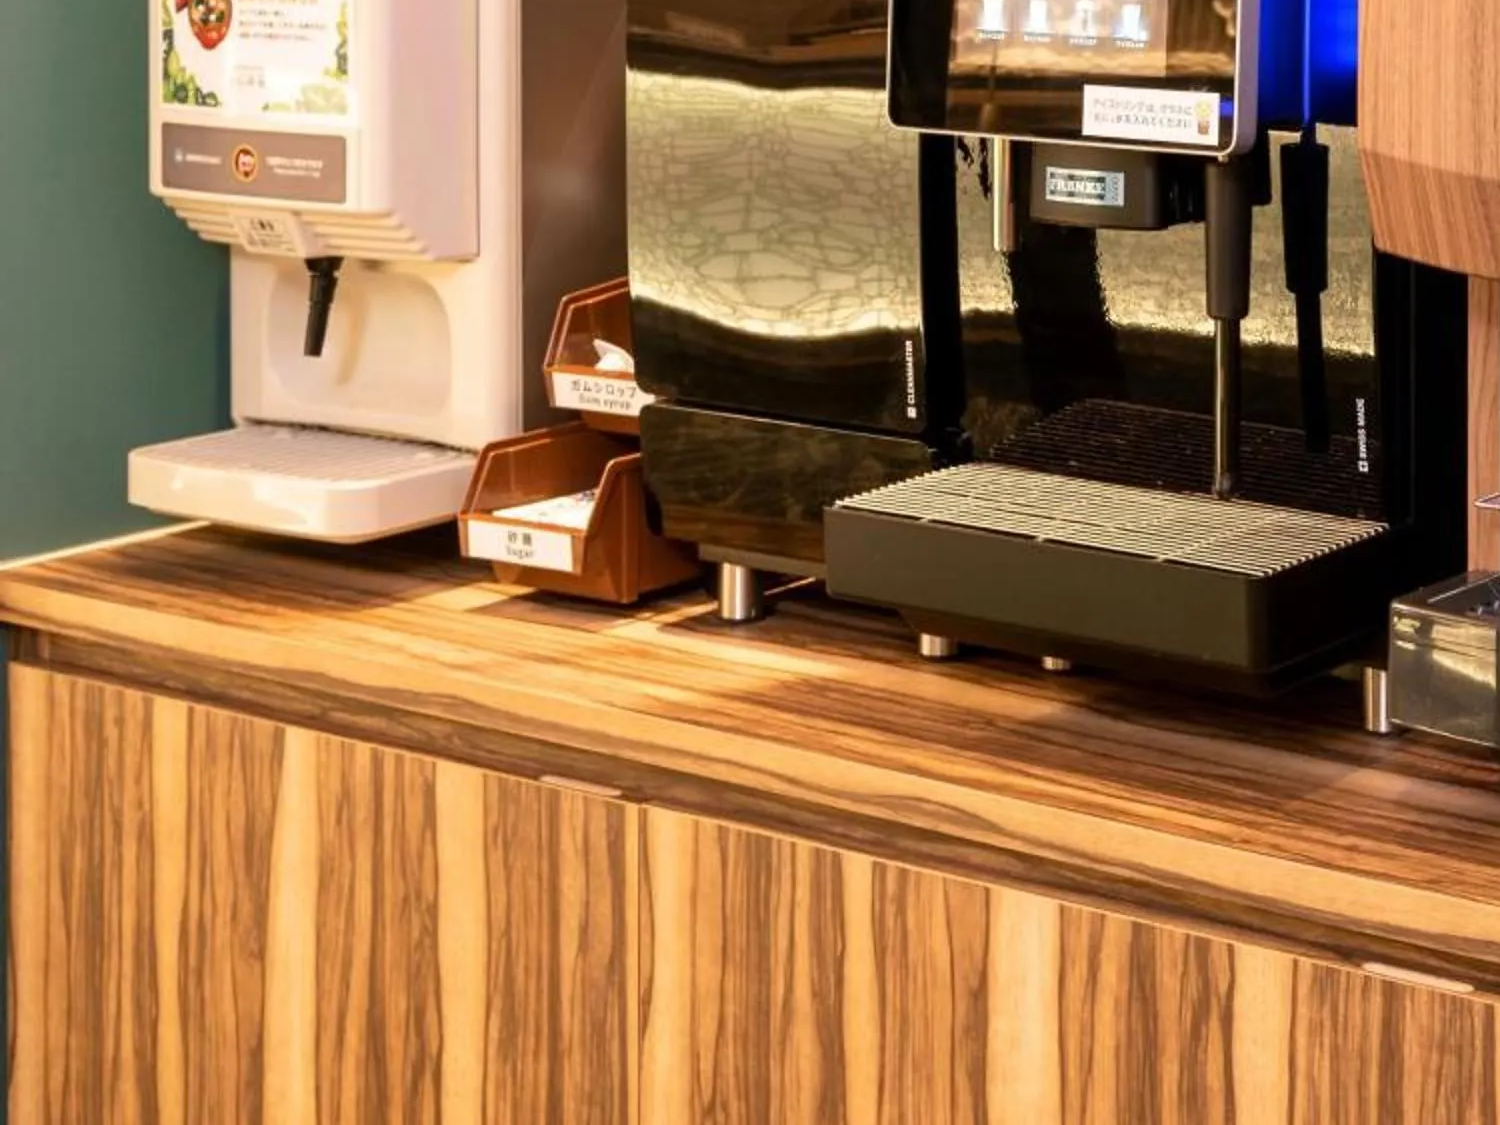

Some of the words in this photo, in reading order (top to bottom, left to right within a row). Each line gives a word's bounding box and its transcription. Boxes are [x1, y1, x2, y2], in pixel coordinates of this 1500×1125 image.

[571, 378, 637, 400] ガムシロップ
